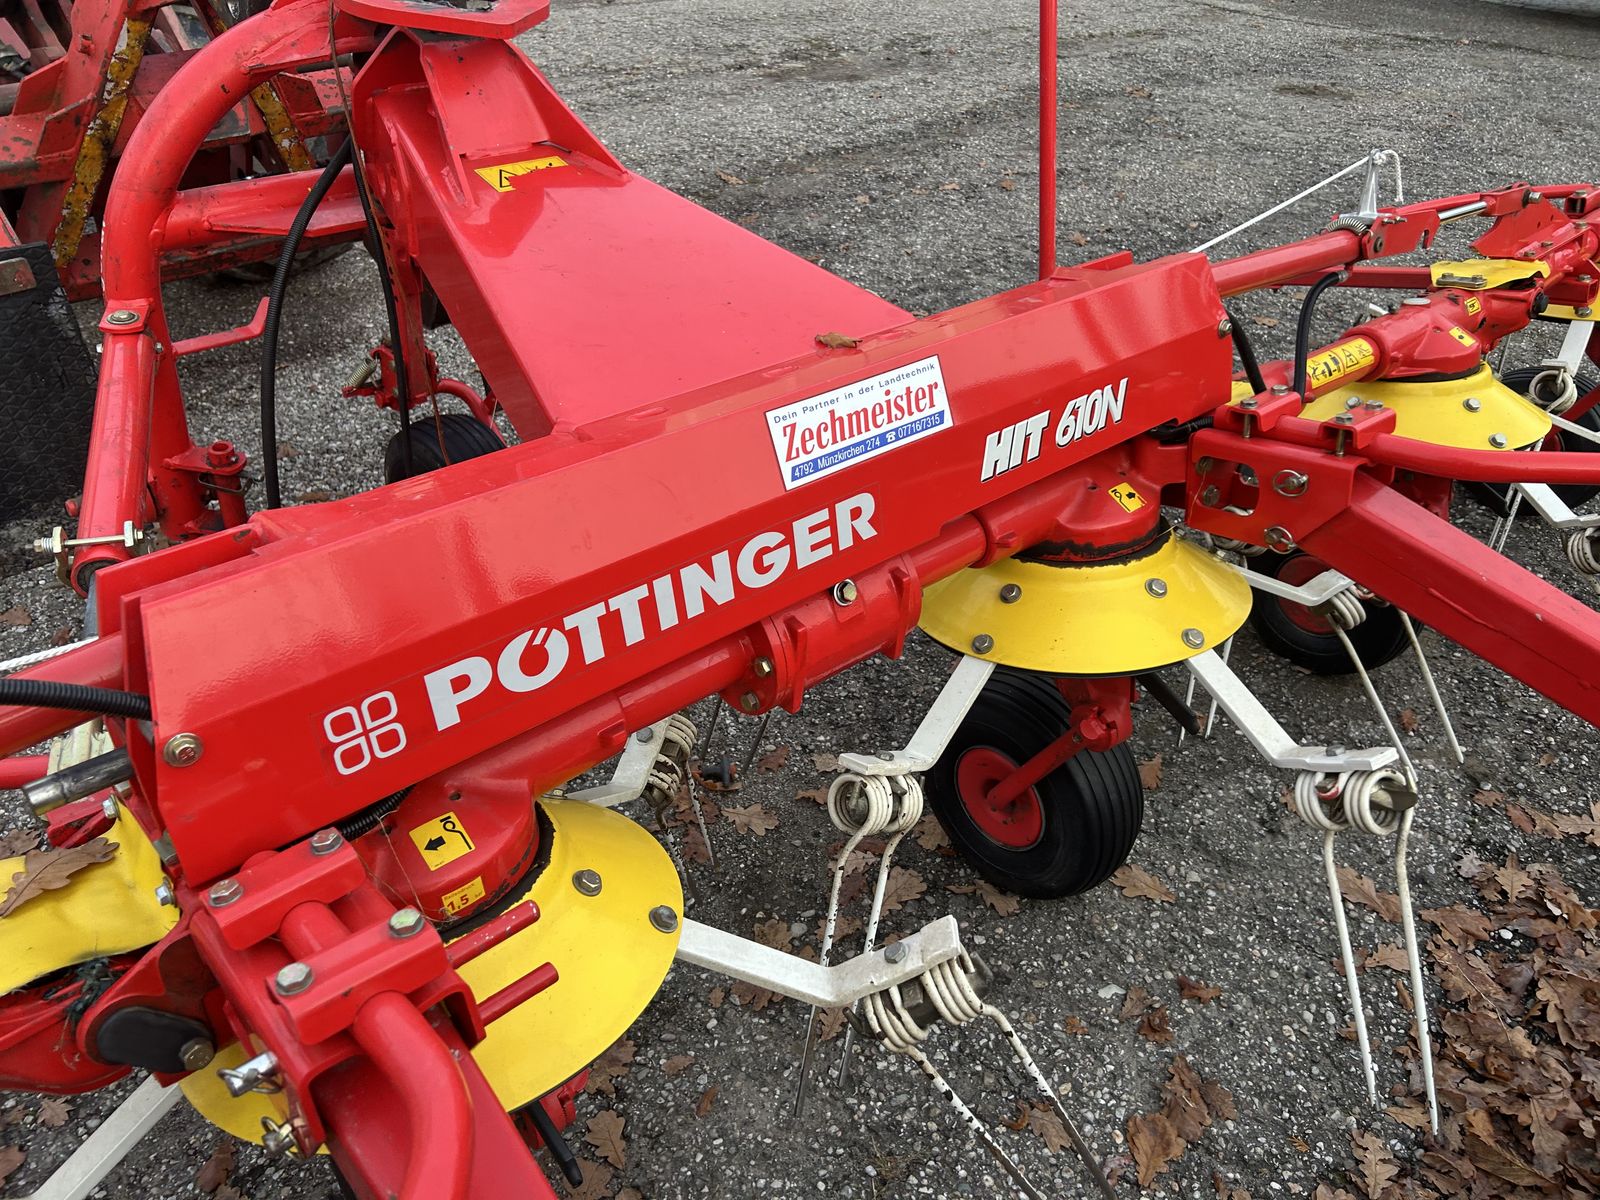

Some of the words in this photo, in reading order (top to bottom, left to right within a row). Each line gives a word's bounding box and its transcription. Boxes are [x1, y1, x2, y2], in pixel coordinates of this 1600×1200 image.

[773, 410, 798, 424] Dein
[802, 396, 840, 415] Partner
[843, 391, 855, 400] in
[858, 384, 875, 396] der
[878, 362, 936, 388] Landtechnik
[782, 381, 939, 463] Zechmeister
[981, 410, 1050, 483] HIT
[1055, 377, 1129, 448] 610N
[794, 462, 815, 478] 4792
[817, 443, 865, 469] Münzkirchen
[866, 438, 881, 452] 274
[897, 412, 941, 439] 07716/7315
[423, 492, 878, 732] PÖTTINGER
